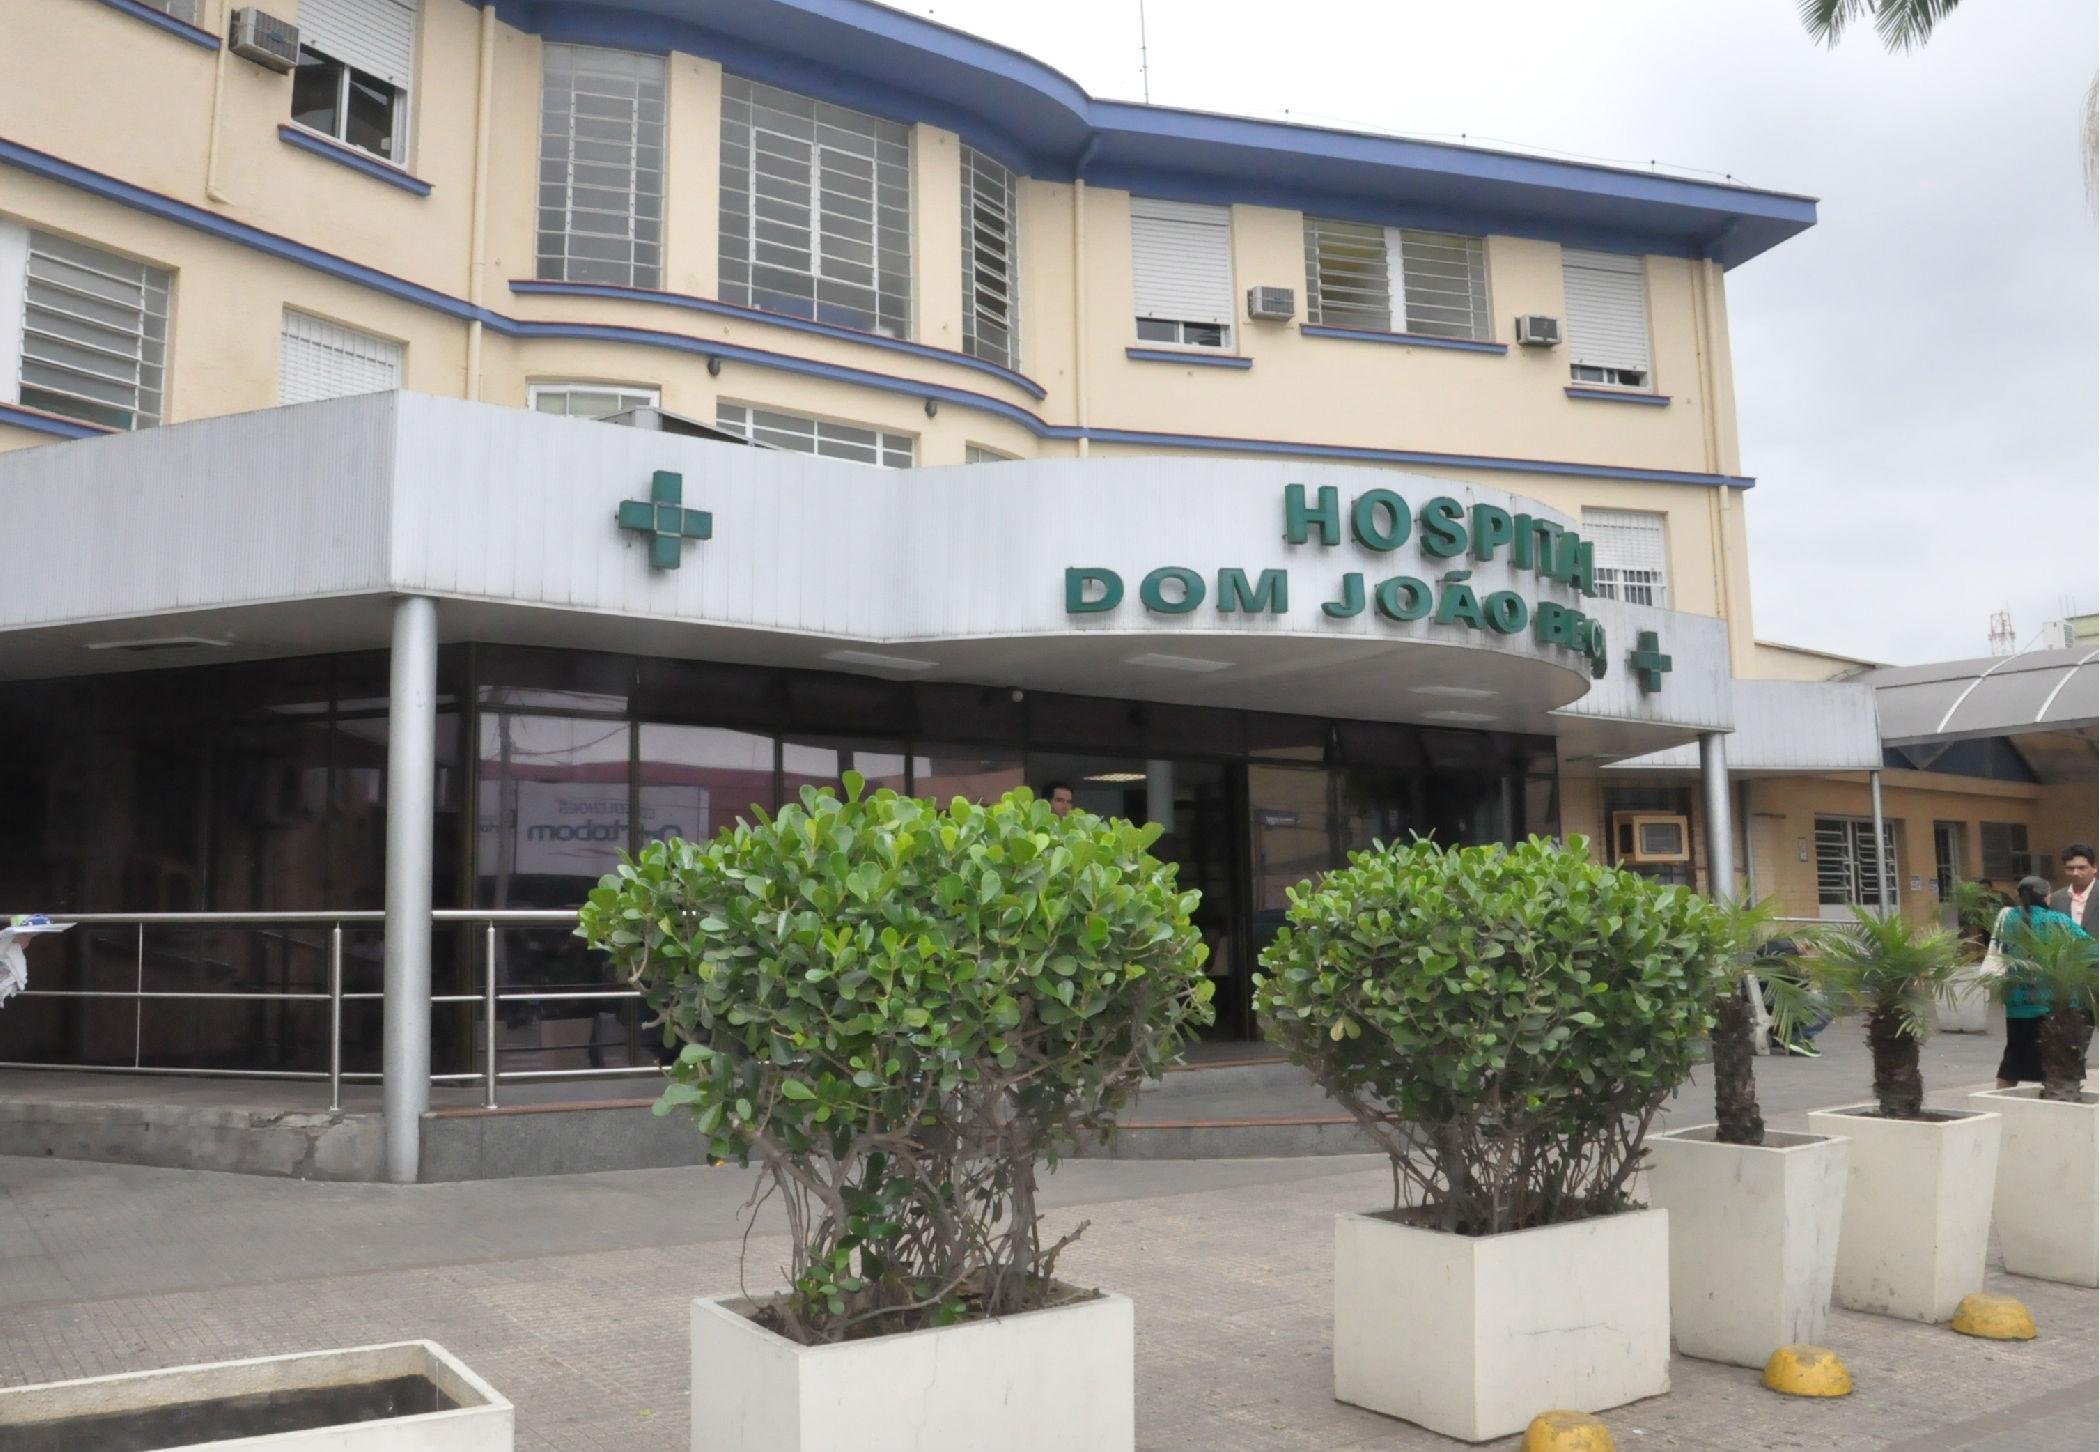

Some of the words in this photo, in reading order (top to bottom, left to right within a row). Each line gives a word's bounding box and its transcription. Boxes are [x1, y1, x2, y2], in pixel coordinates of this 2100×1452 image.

[1283, 482, 1598, 598] HOSPITAL
[1064, 566, 1289, 615] DOM
[1320, 570, 1529, 635] JOÃO
[1535, 601, 1608, 680] BEC
